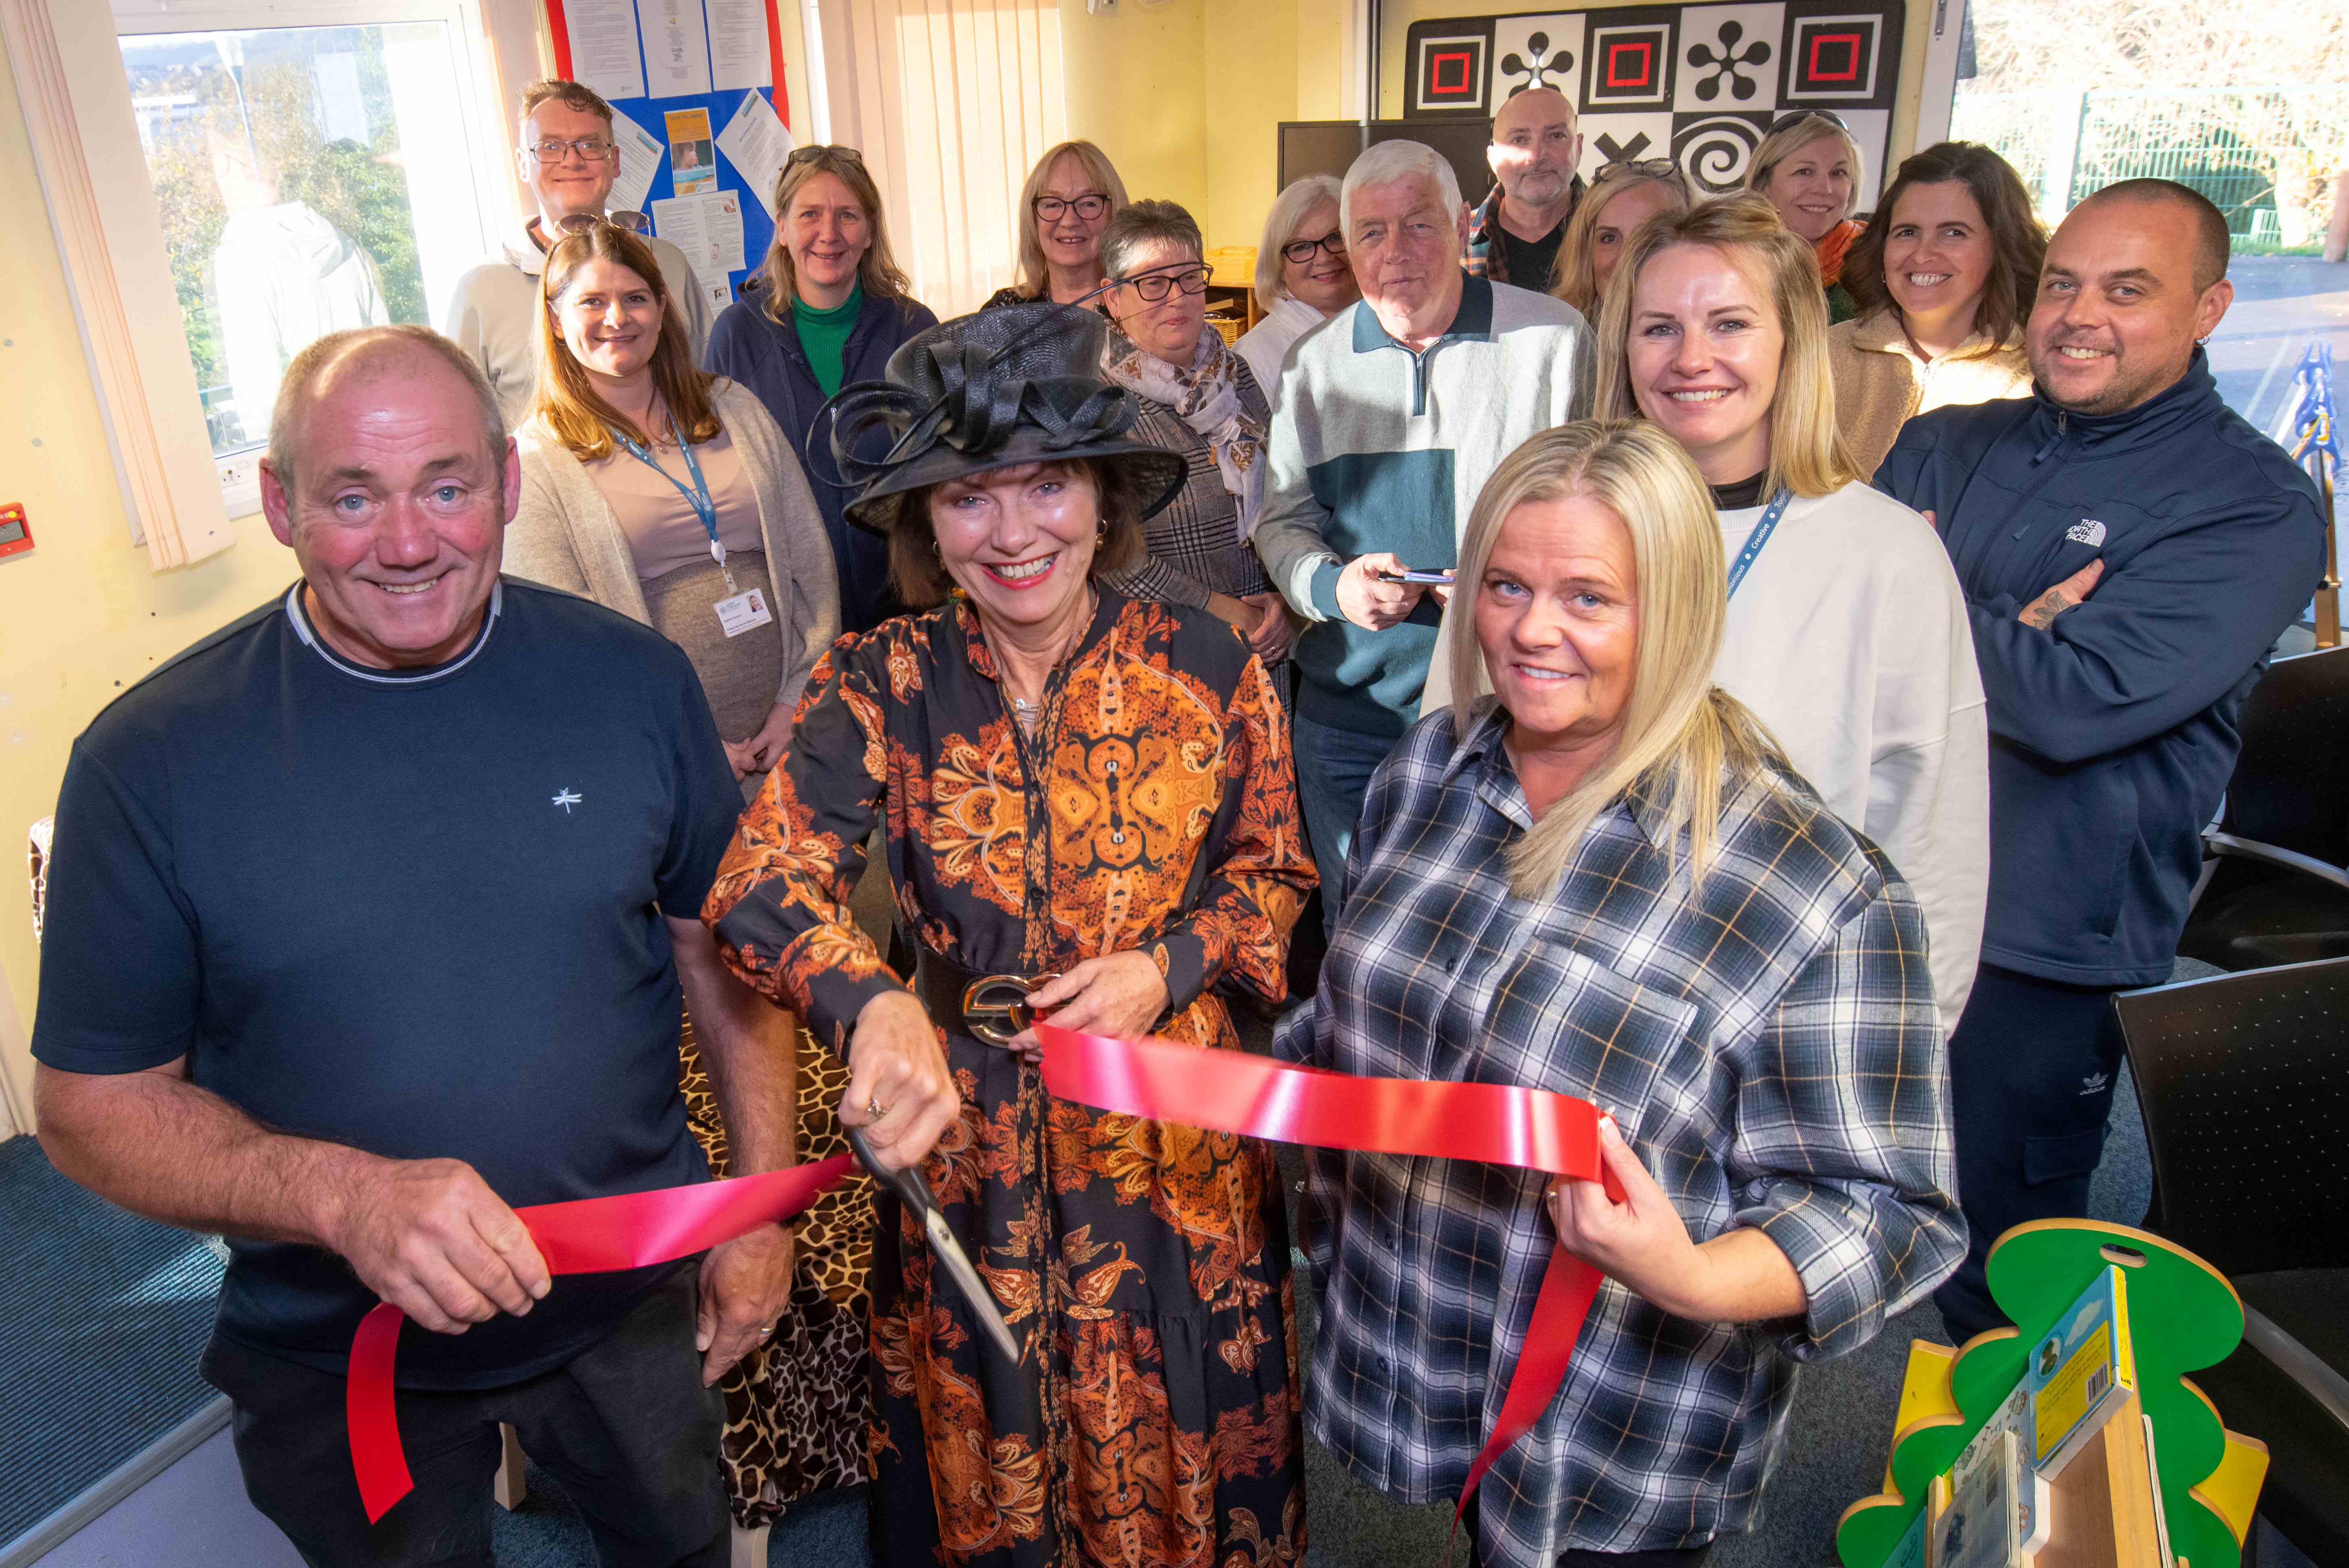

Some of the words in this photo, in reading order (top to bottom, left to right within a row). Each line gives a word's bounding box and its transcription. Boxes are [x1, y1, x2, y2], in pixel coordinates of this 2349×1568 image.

[2080, 519, 2097, 528] THE
[1751, 523, 1770, 549] Creative
[2065, 532, 2087, 541] FACE
